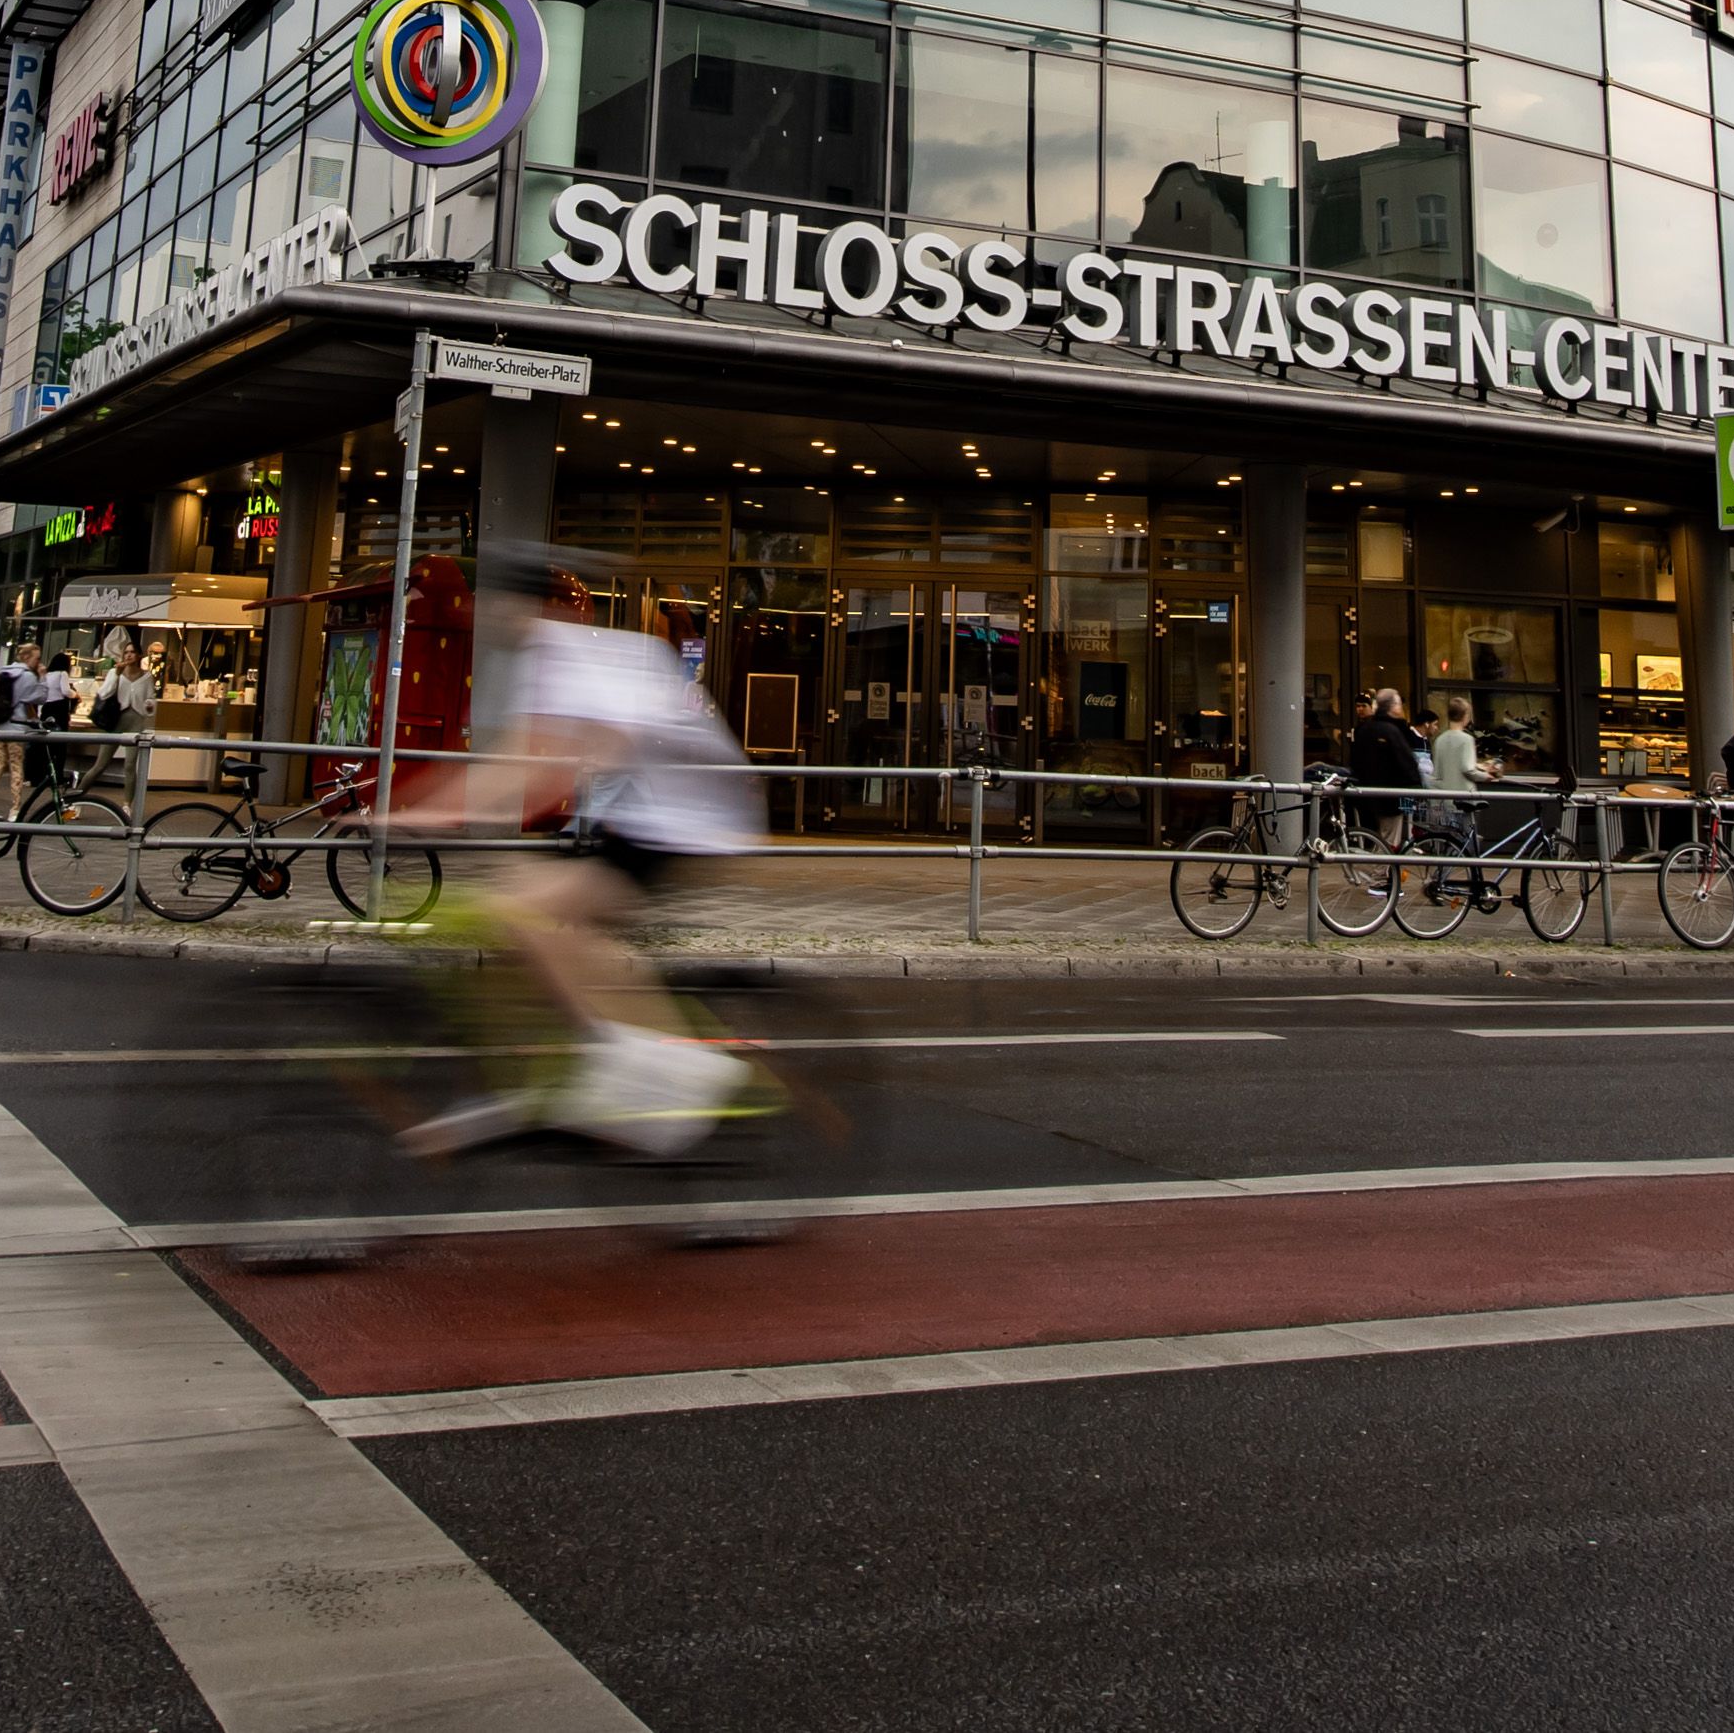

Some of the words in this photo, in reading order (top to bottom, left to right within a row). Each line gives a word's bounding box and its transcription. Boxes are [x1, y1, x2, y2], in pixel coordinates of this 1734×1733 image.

[48, 93, 108, 206] REWE
[445, 351, 581, 384] Walther-Schreiber-Platz
[55, 511, 76, 544] PIZZA
[237, 516, 250, 539] di
[1071, 622, 1108, 637] back
[1070, 639, 1110, 652] WERK
[1192, 766, 1226, 779] back
